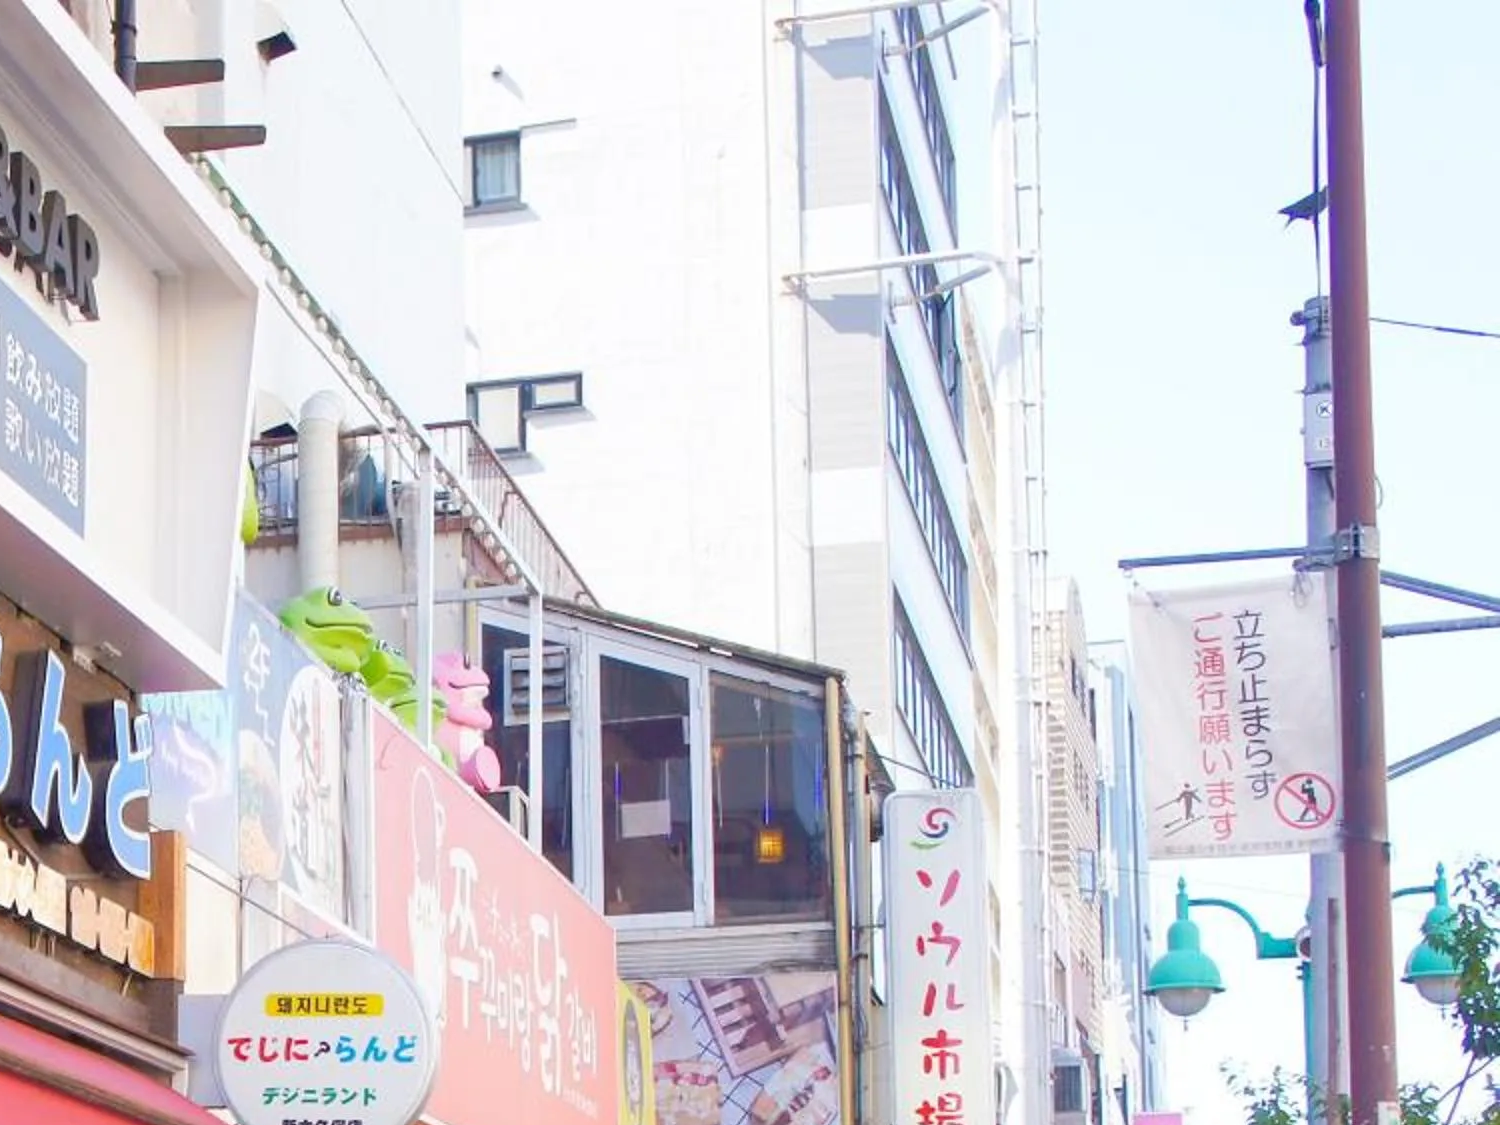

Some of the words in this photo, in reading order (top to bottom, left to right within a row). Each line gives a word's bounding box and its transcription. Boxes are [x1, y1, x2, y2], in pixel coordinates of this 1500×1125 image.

[6, 332, 82, 445] 飲み放題
[6, 399, 82, 509] 歌い放題
[1193, 612, 1237, 842] ご通行願います
[1231, 608, 1277, 800] 立ち止まらず
[262, 1086, 378, 1107] デジニランド
